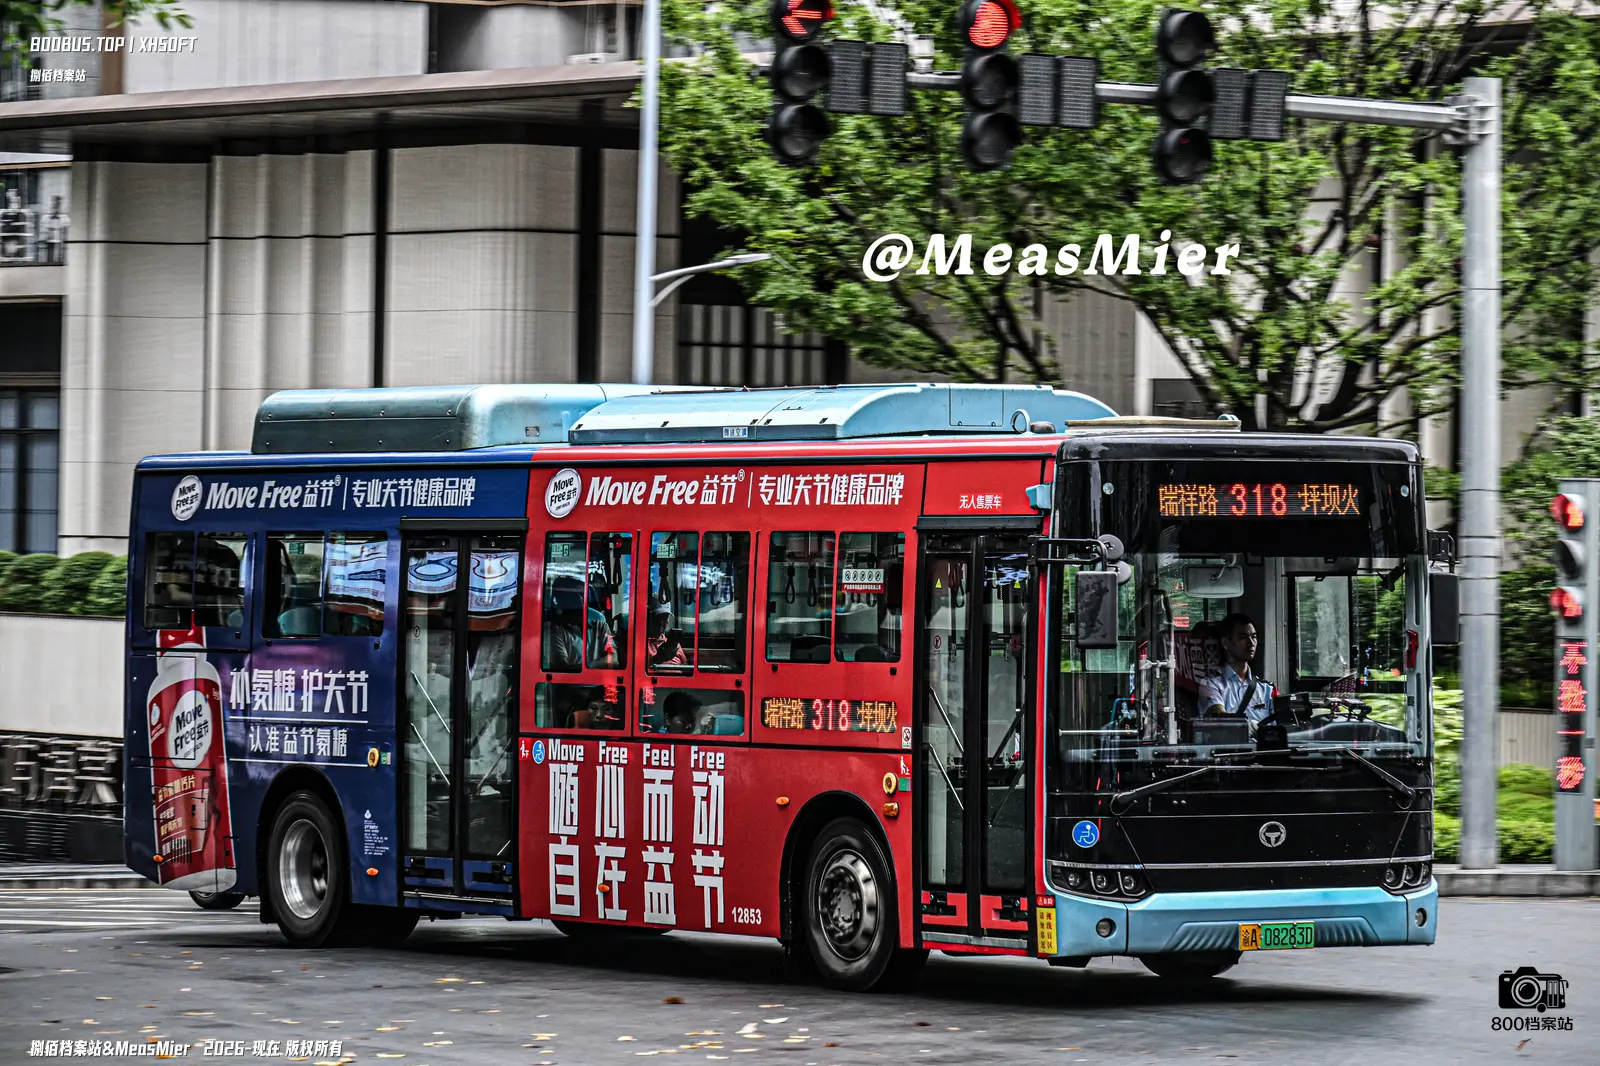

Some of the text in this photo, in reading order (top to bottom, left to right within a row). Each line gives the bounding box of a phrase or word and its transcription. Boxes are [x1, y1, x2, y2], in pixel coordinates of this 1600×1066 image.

[178, 483, 196, 498] Move
[205, 482, 258, 509] Move
[258, 480, 302, 508] Free
[351, 476, 476, 507] 专业关节健康品牌
[550, 491, 566, 506] Free
[553, 477, 574, 493] Move
[584, 476, 647, 506] Move
[647, 475, 699, 505] Free
[758, 472, 905, 506] 专业关节健康品牌
[1158, 483, 1360, 516] 瑞祥路 318 坪坝火
[959, 494, 1002, 510] 无人售票车
[229, 667, 369, 714] 补氨糖 护关节
[175, 704, 203, 733] Move
[812, 698, 850, 731] 318
[856, 700, 897, 733] 坪坝火
[173, 727, 197, 756] Free
[548, 738, 725, 770] Move Free Feel Free
[731, 907, 762, 925] 12853
